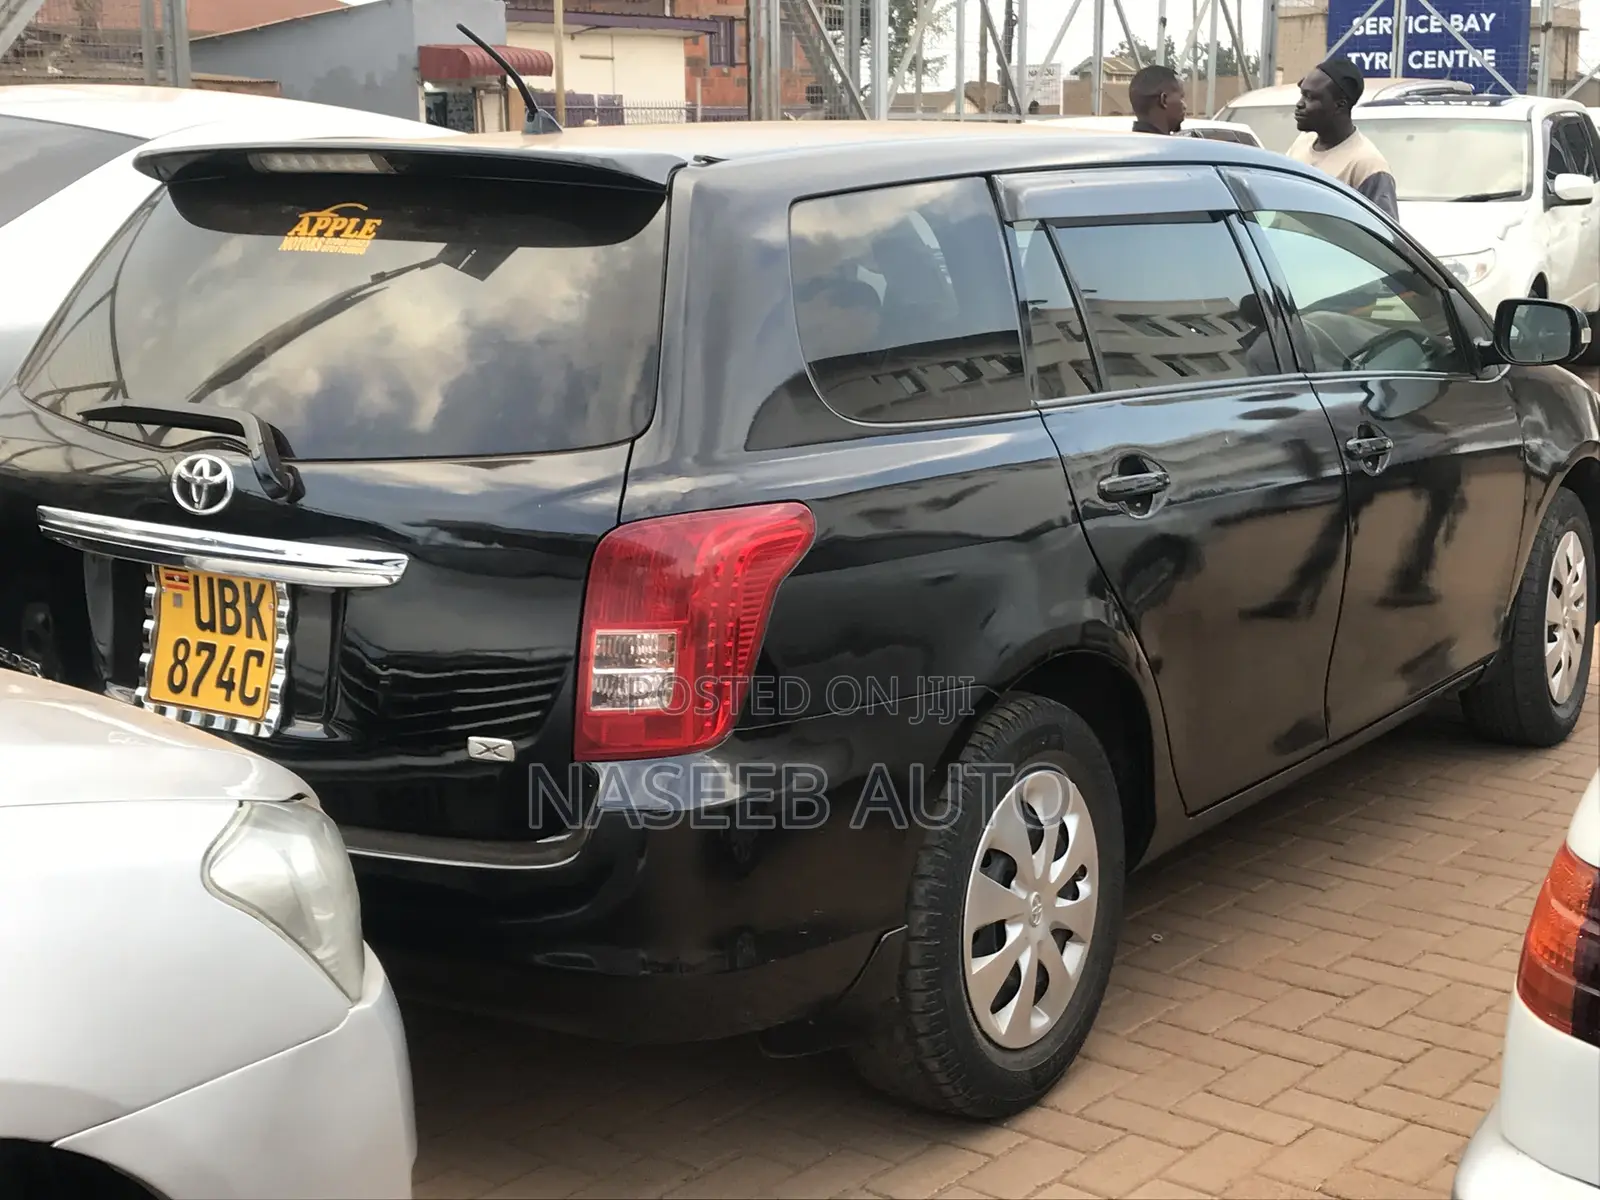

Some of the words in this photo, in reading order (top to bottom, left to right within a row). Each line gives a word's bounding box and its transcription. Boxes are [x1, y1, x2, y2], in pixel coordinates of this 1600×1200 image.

[1352, 15, 1442, 36] SERICE
[1450, 13, 1496, 33] BAY
[1408, 49, 1496, 70] CENTRE
[287, 216, 382, 240] APPLE
[193, 574, 267, 641] UBK
[167, 638, 265, 706] 874C
